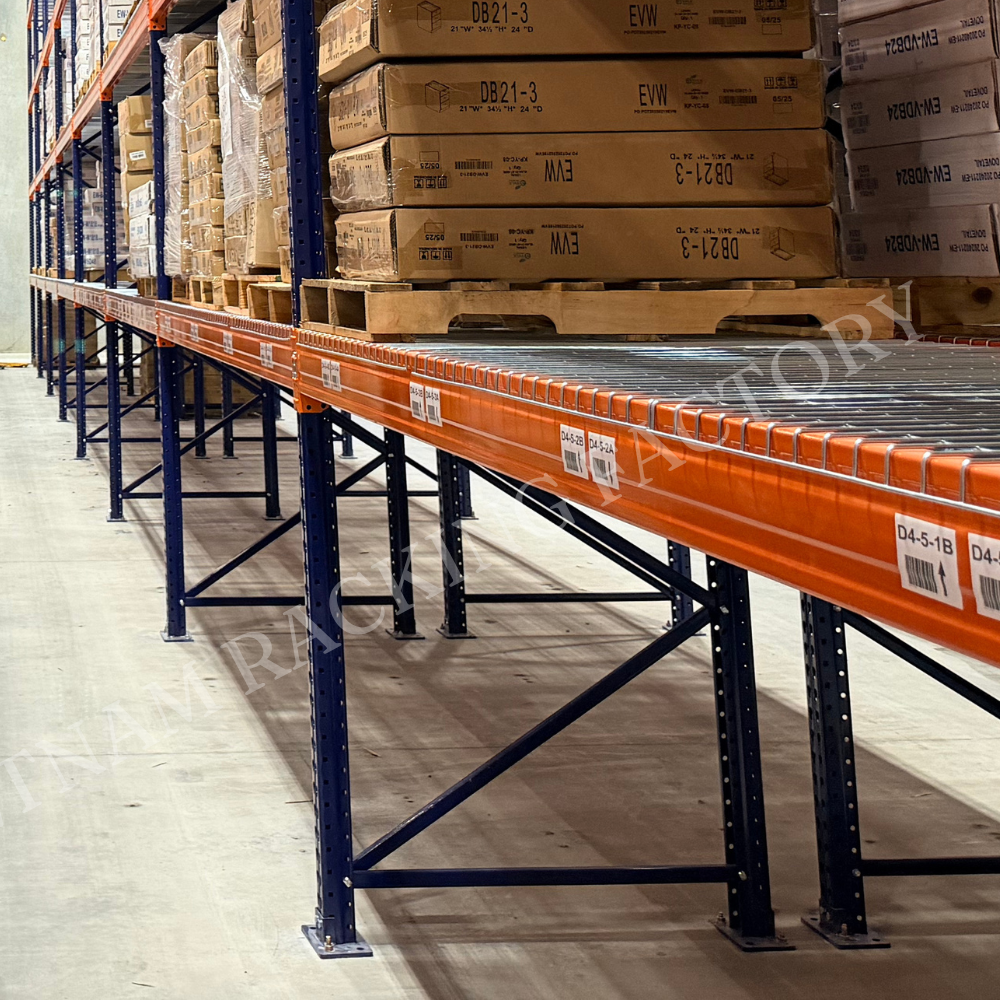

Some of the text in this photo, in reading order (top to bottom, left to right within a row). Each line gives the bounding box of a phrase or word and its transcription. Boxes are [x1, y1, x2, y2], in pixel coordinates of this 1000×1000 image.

[472, 1, 529, 23] DB21-3
[629, 4, 657, 27] EVW
[960, 16, 984, 29] DOVETAIL
[885, 28, 939, 56] EW-VDB24
[480, 81, 537, 103] DB21-3
[638, 84, 667, 106] EVW
[963, 86, 988, 98] DOVETAIL
[887, 97, 941, 122] EW-VDB24
[545, 159, 573, 182] EVW
[675, 162, 733, 185] DB21-3
[896, 164, 951, 186] EW-VDB24
[551, 232, 579, 255] EVW
[885, 233, 939, 252] EW-VDB24
[961, 229, 986, 238] DOVETAIL
[681, 237, 739, 260] DB21-3
[561, 431, 584, 447] D4-5-2B
[589, 438, 614, 455] D4-5-2A
[897, 524, 954, 555] D4-5-1B
[972, 544, 1000, 565] D4-
